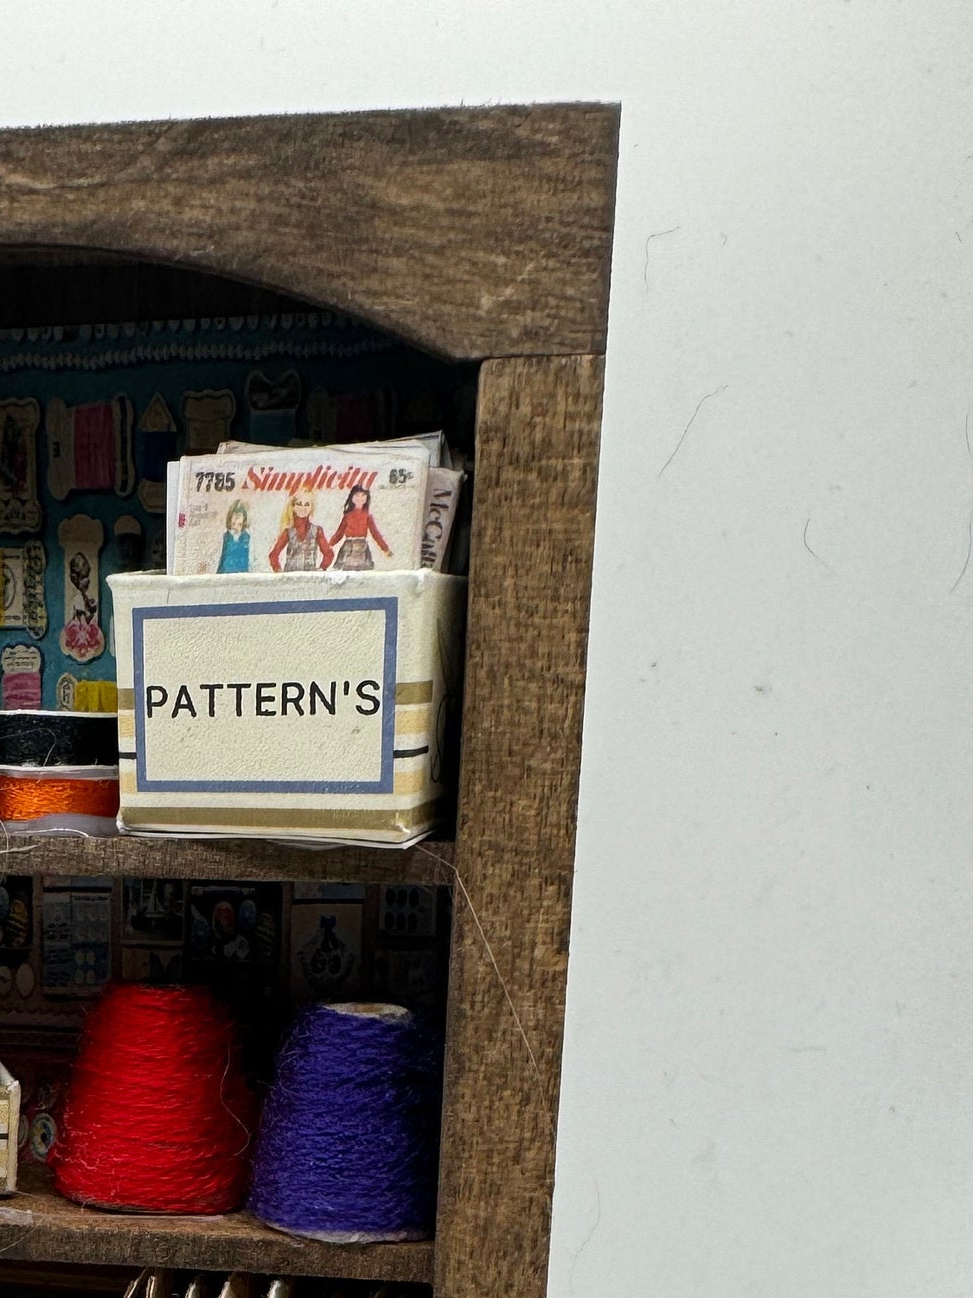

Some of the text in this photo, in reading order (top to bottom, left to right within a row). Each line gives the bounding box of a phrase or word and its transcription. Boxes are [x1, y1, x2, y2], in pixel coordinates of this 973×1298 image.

[195, 471, 235, 492] 7785
[243, 464, 379, 496] Simplicity
[146, 679, 381, 719] PATTERN'S
